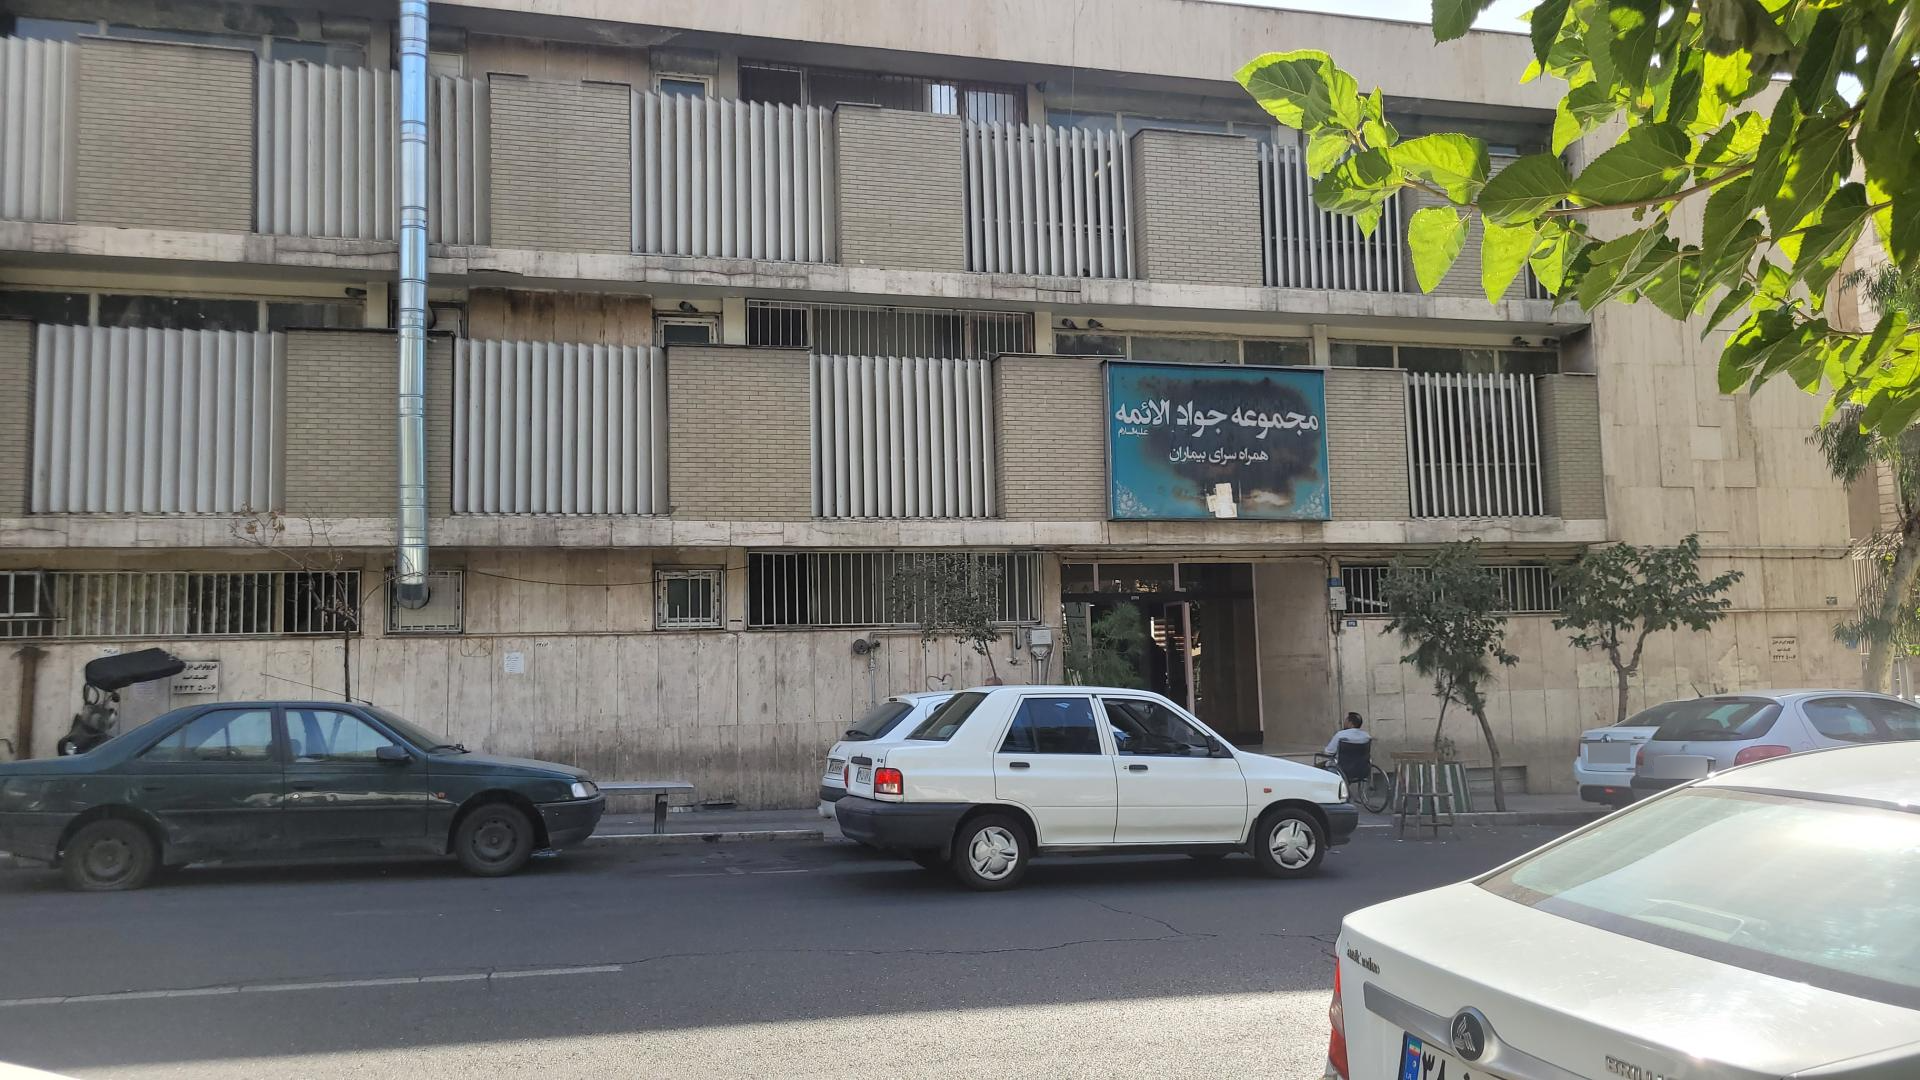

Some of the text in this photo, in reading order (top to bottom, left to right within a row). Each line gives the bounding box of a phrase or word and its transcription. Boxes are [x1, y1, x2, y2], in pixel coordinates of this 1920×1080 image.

[1176, 401, 1228, 437] جواد
[1231, 406, 1319, 439] مجموعه
[1169, 446, 1269, 465] همراه سرای بیماران
